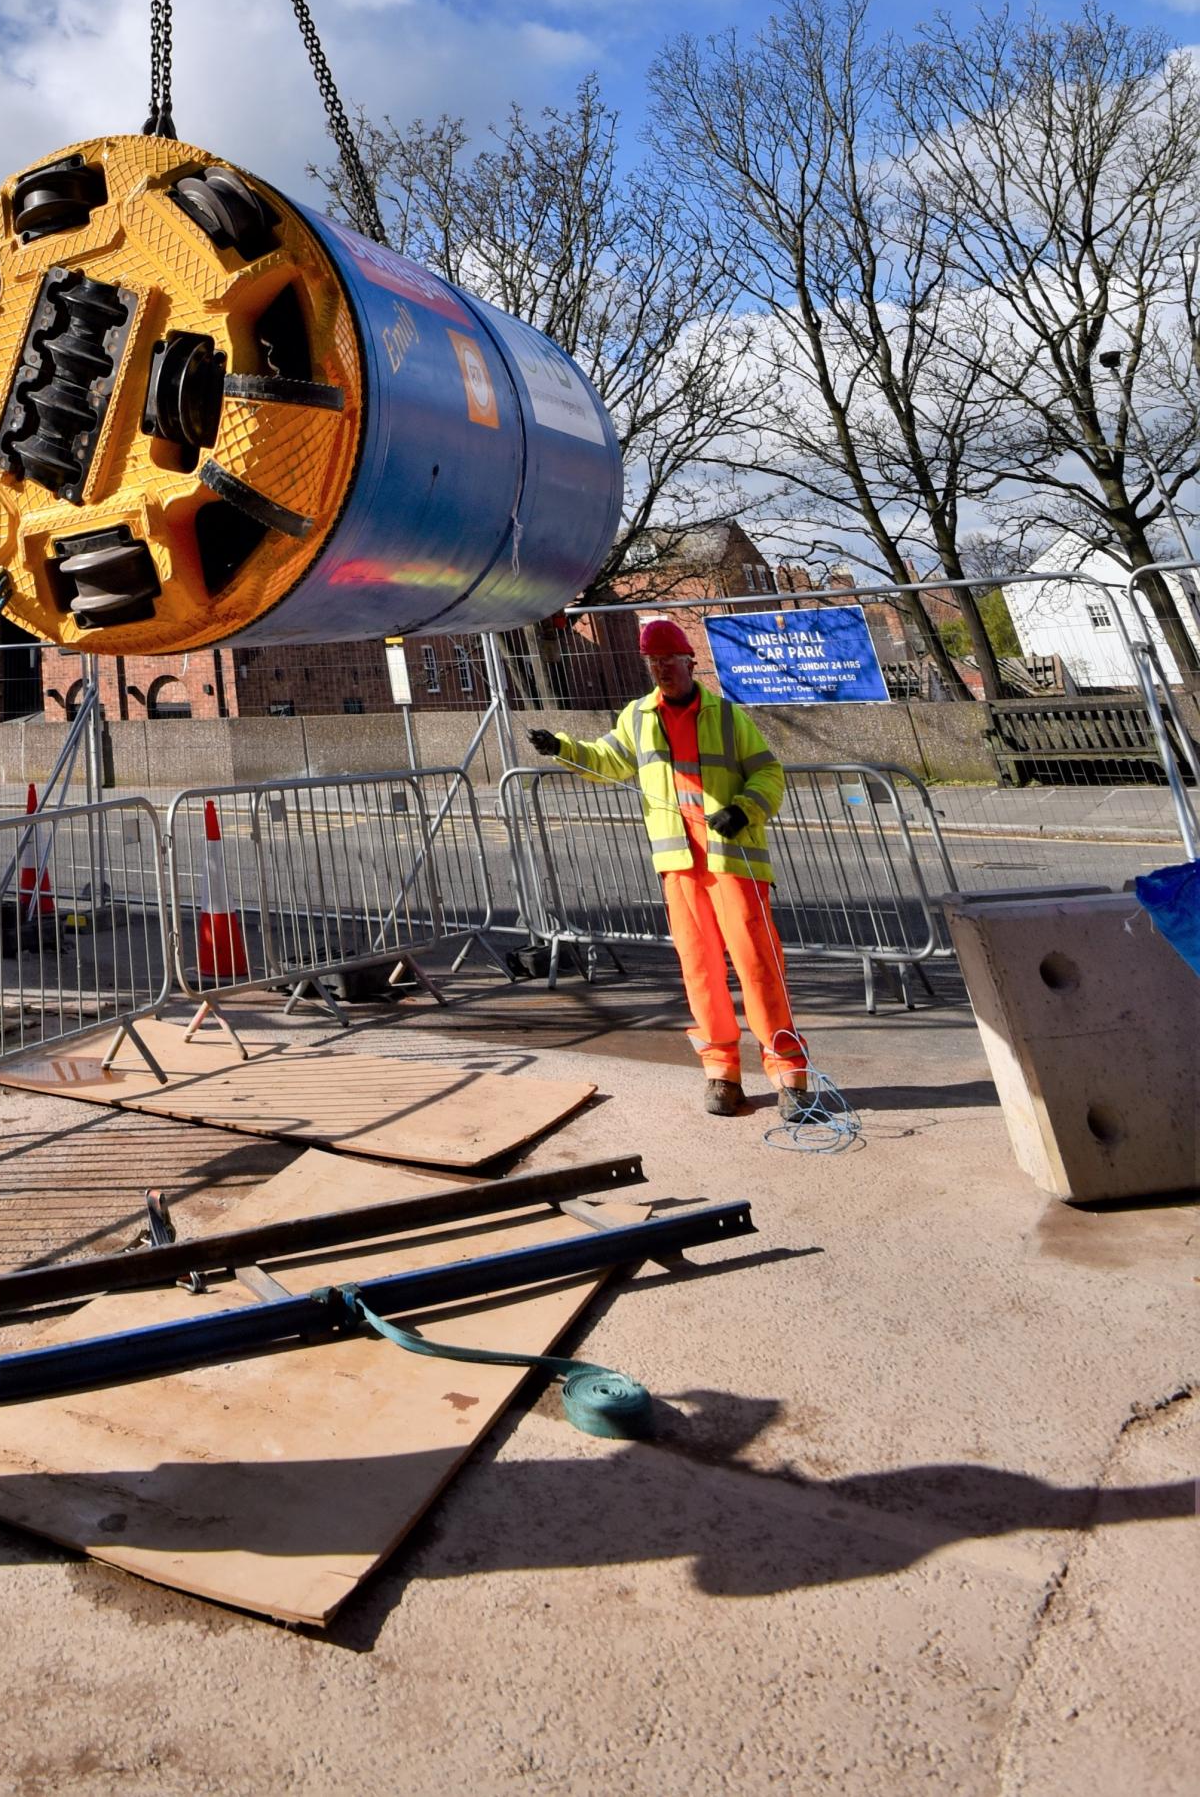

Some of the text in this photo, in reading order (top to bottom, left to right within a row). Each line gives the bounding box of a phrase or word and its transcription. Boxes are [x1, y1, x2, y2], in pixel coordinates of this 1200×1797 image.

[321, 219, 457, 305] Donegan
[383, 299, 421, 375] Emily
[749, 631, 824, 646] LINENHALL
[756, 645, 825, 660] CAR PARK
[731, 665, 752, 674] OPEN
[754, 663, 788, 673] MONDAY
[797, 662, 829, 671] SUNDAY
[831, 661, 842, 670] 24
[843, 660, 860, 669] HRS
